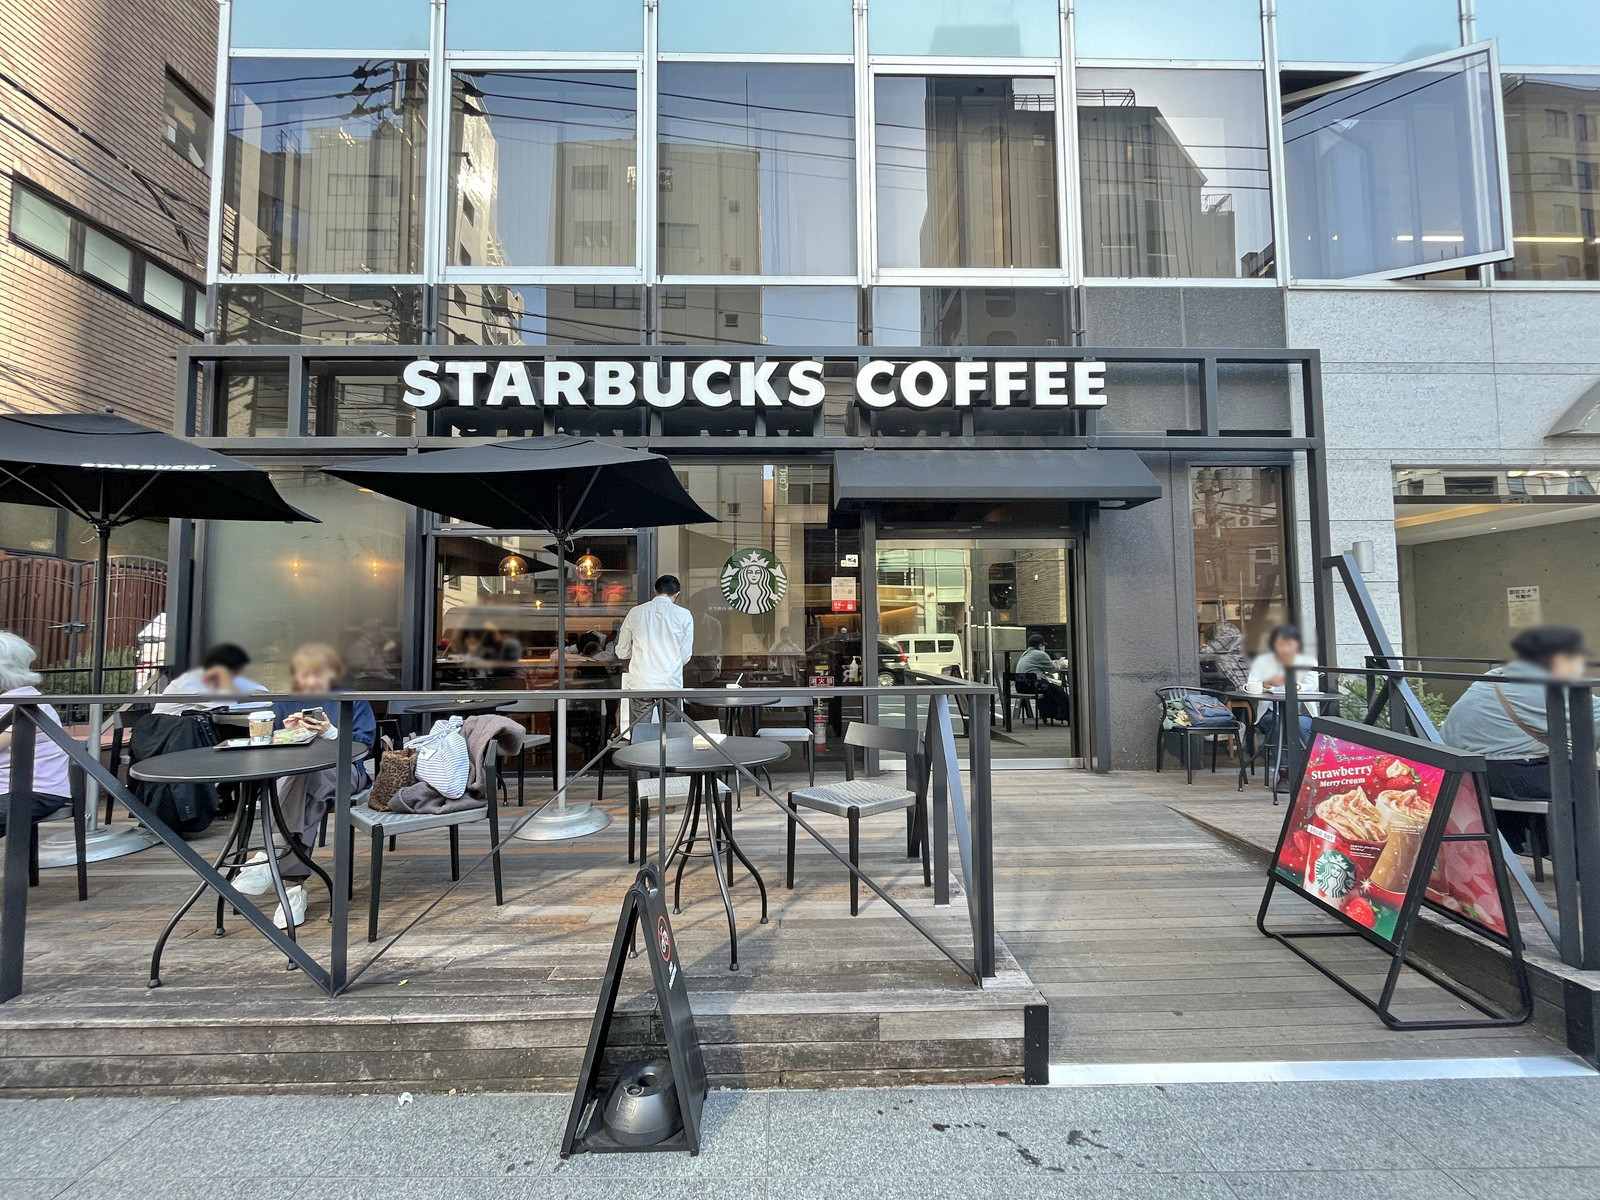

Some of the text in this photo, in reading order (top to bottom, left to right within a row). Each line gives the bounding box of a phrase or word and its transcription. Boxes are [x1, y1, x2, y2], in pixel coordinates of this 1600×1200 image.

[402, 360, 1107, 408] STARBUCKS COFFEE
[1311, 765, 1373, 780] Strawberry
[1341, 777, 1366, 785] Cream
[1309, 827, 1334, 841] SOLD OUT
